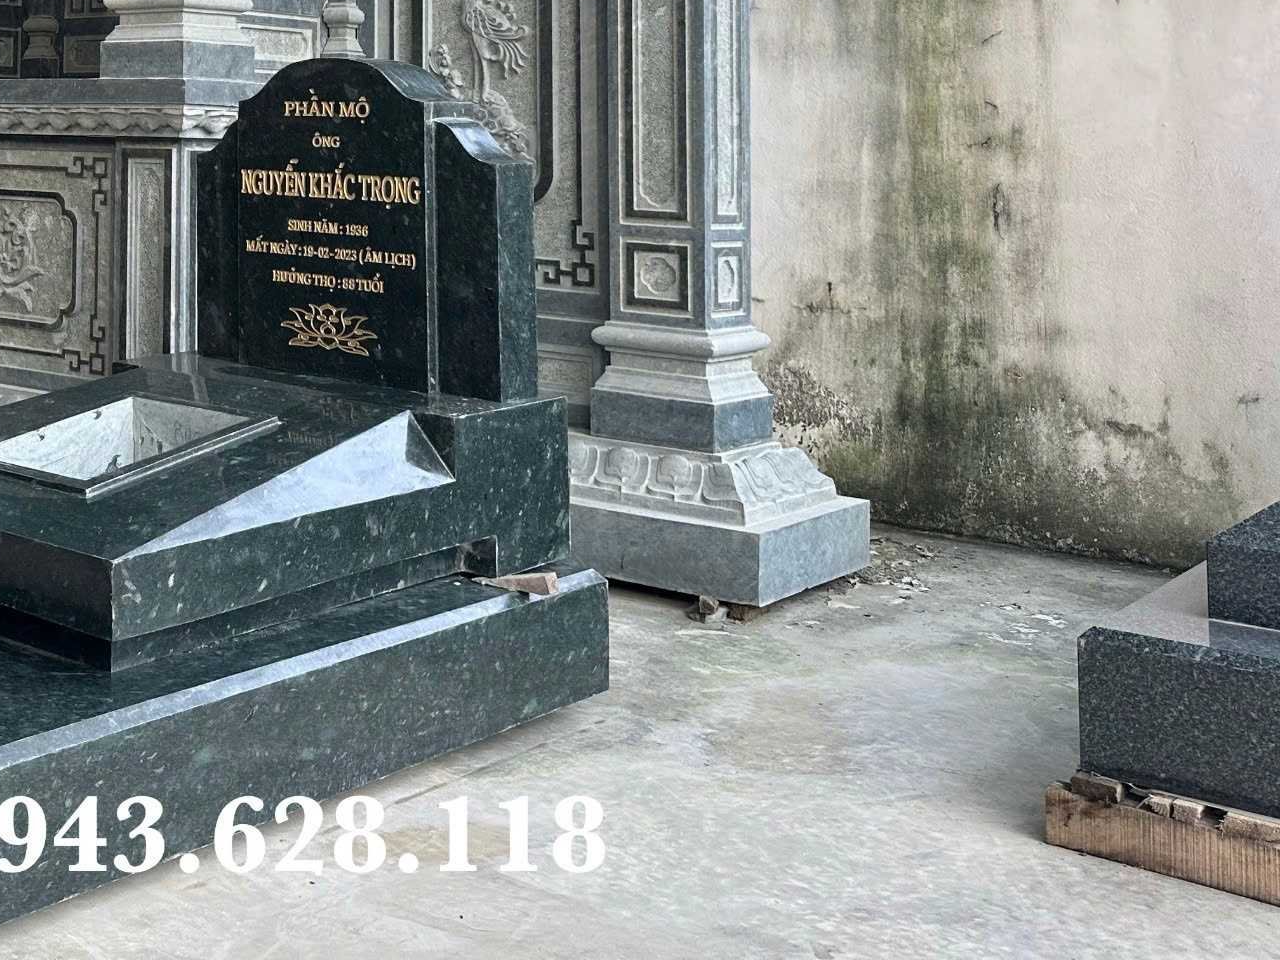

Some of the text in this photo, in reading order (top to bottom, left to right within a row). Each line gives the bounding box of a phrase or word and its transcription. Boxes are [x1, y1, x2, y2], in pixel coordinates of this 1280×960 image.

[284, 89, 370, 123] PHẦN MỘ
[312, 132, 340, 148] ÔNG
[240, 158, 421, 209] NGUYỄN KHẮC TRỌNG
[287, 218, 313, 232] SINH
[346, 224, 369, 237] 1936
[246, 234, 270, 252] MẤT
